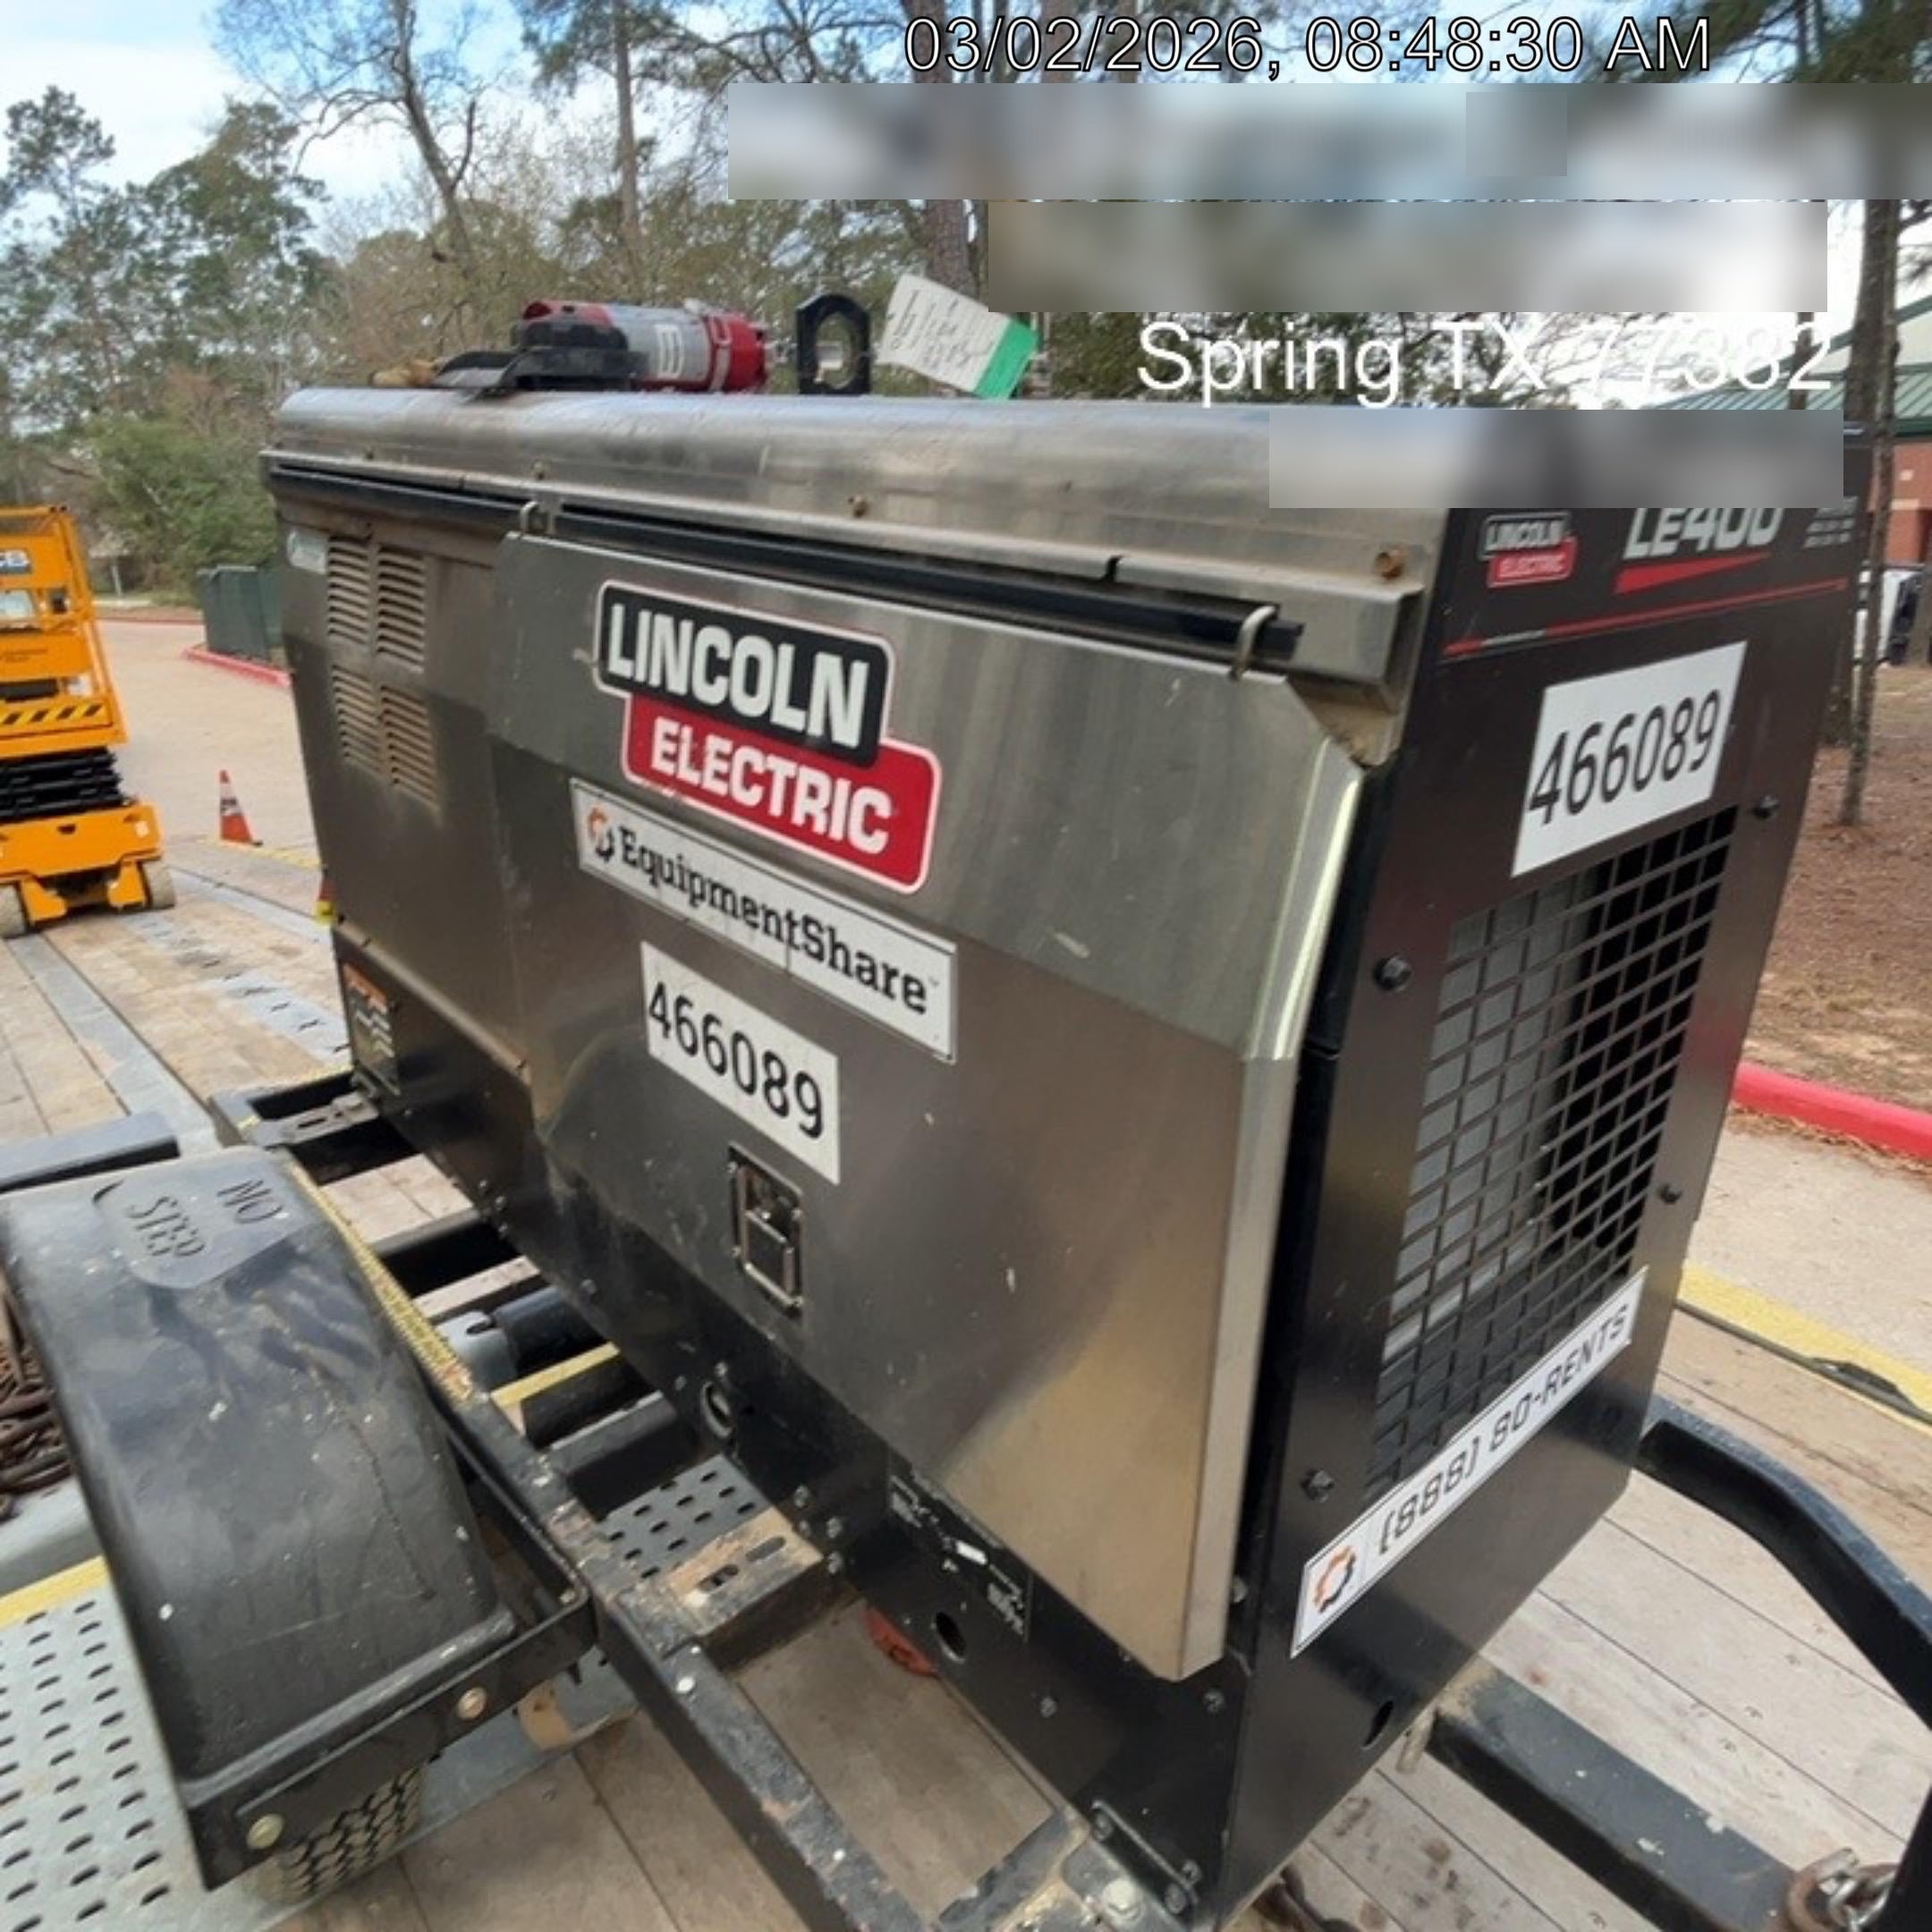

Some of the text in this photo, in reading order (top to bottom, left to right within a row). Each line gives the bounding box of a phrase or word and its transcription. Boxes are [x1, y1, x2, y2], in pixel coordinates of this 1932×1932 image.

[1484, 520, 1564, 551] LINCOLN
[606, 603, 869, 748] LINCOLN
[650, 716, 893, 856] ELECTRIC
[1528, 688, 1722, 826] 466089
[619, 826, 927, 1015] EquipmentShare
[648, 981, 824, 1140] 466089
[128, 1196, 206, 1257] STEP
[216, 1179, 284, 1224] NO
[1377, 1302, 1629, 1555] (888) 80-RENTS
